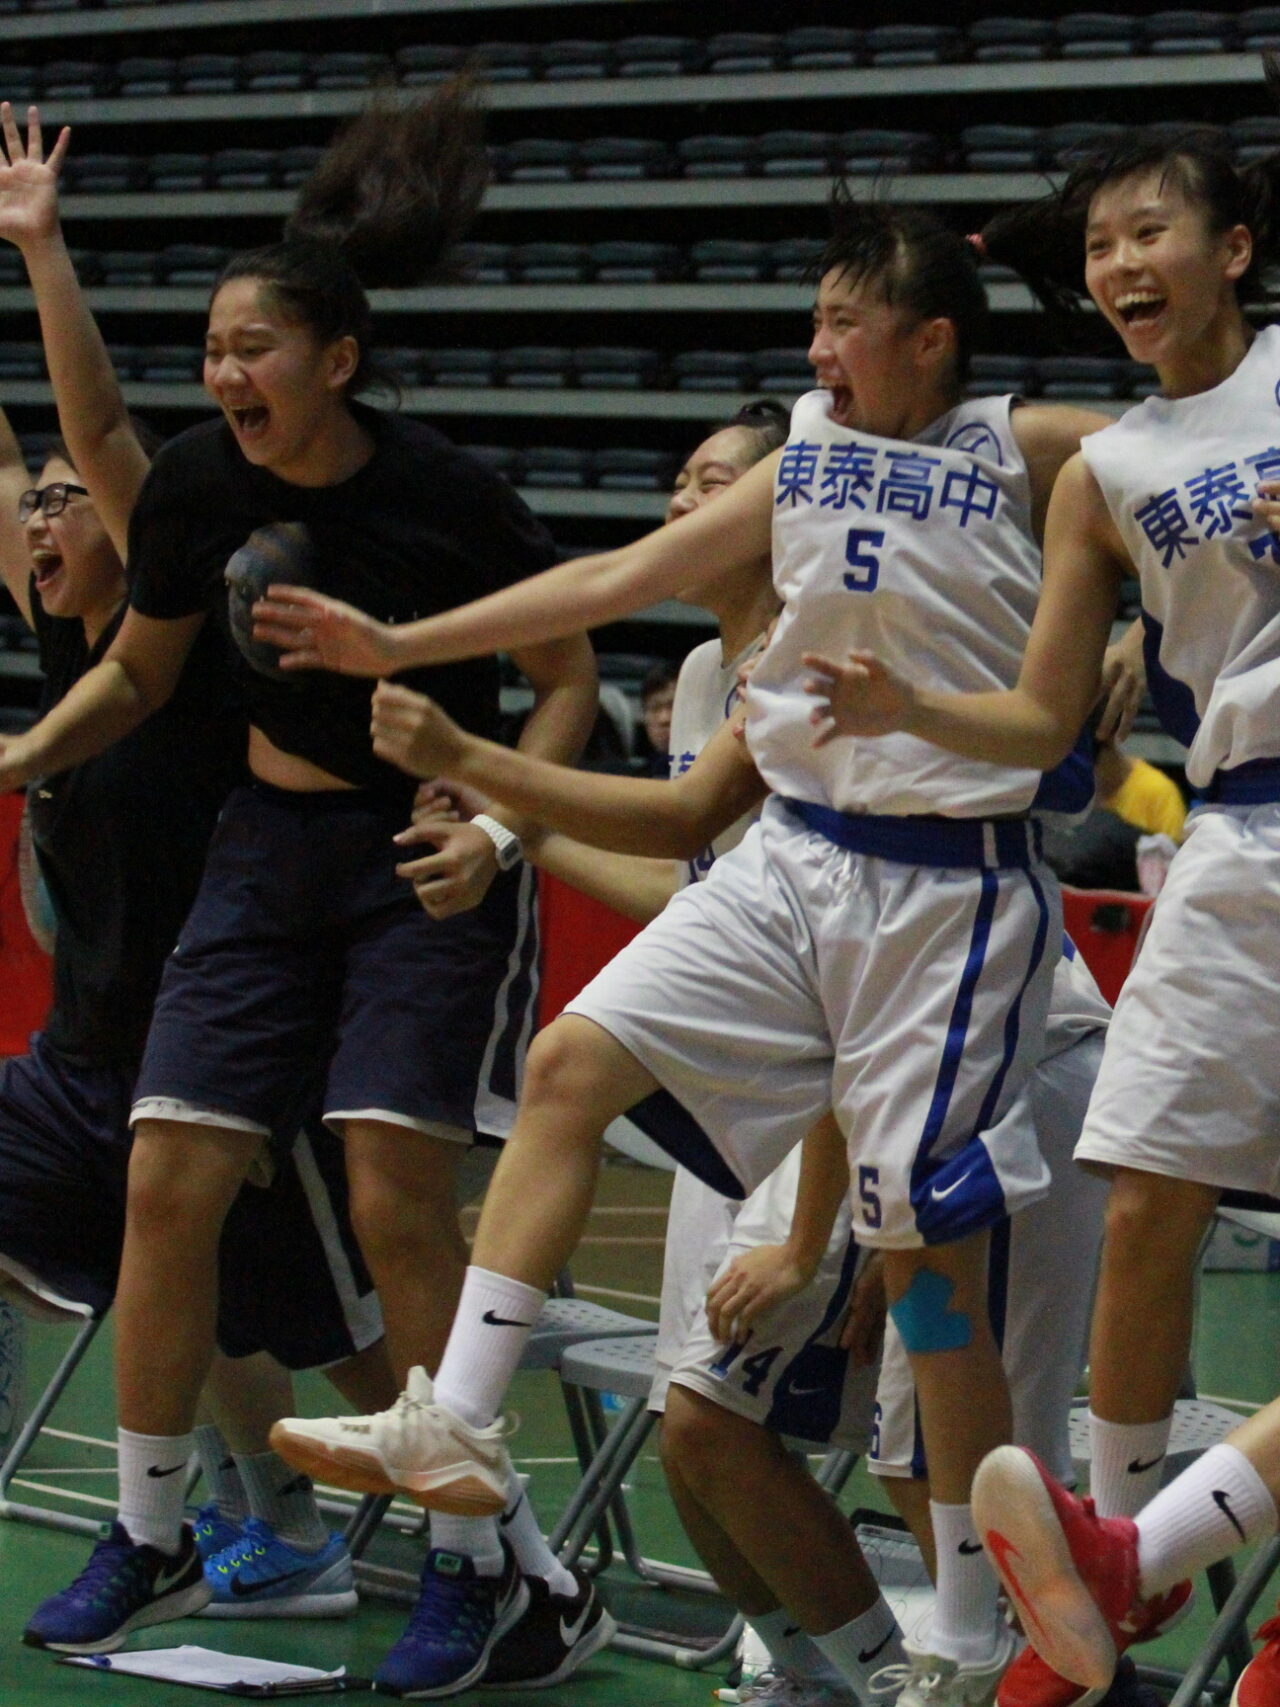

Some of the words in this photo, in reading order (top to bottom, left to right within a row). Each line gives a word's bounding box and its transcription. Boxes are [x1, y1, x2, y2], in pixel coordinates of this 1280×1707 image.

[776, 440, 999, 528] 東泰高中
[842, 528, 886, 593] 5
[857, 1165, 883, 1229] 5
[708, 1328, 785, 1398] 14
